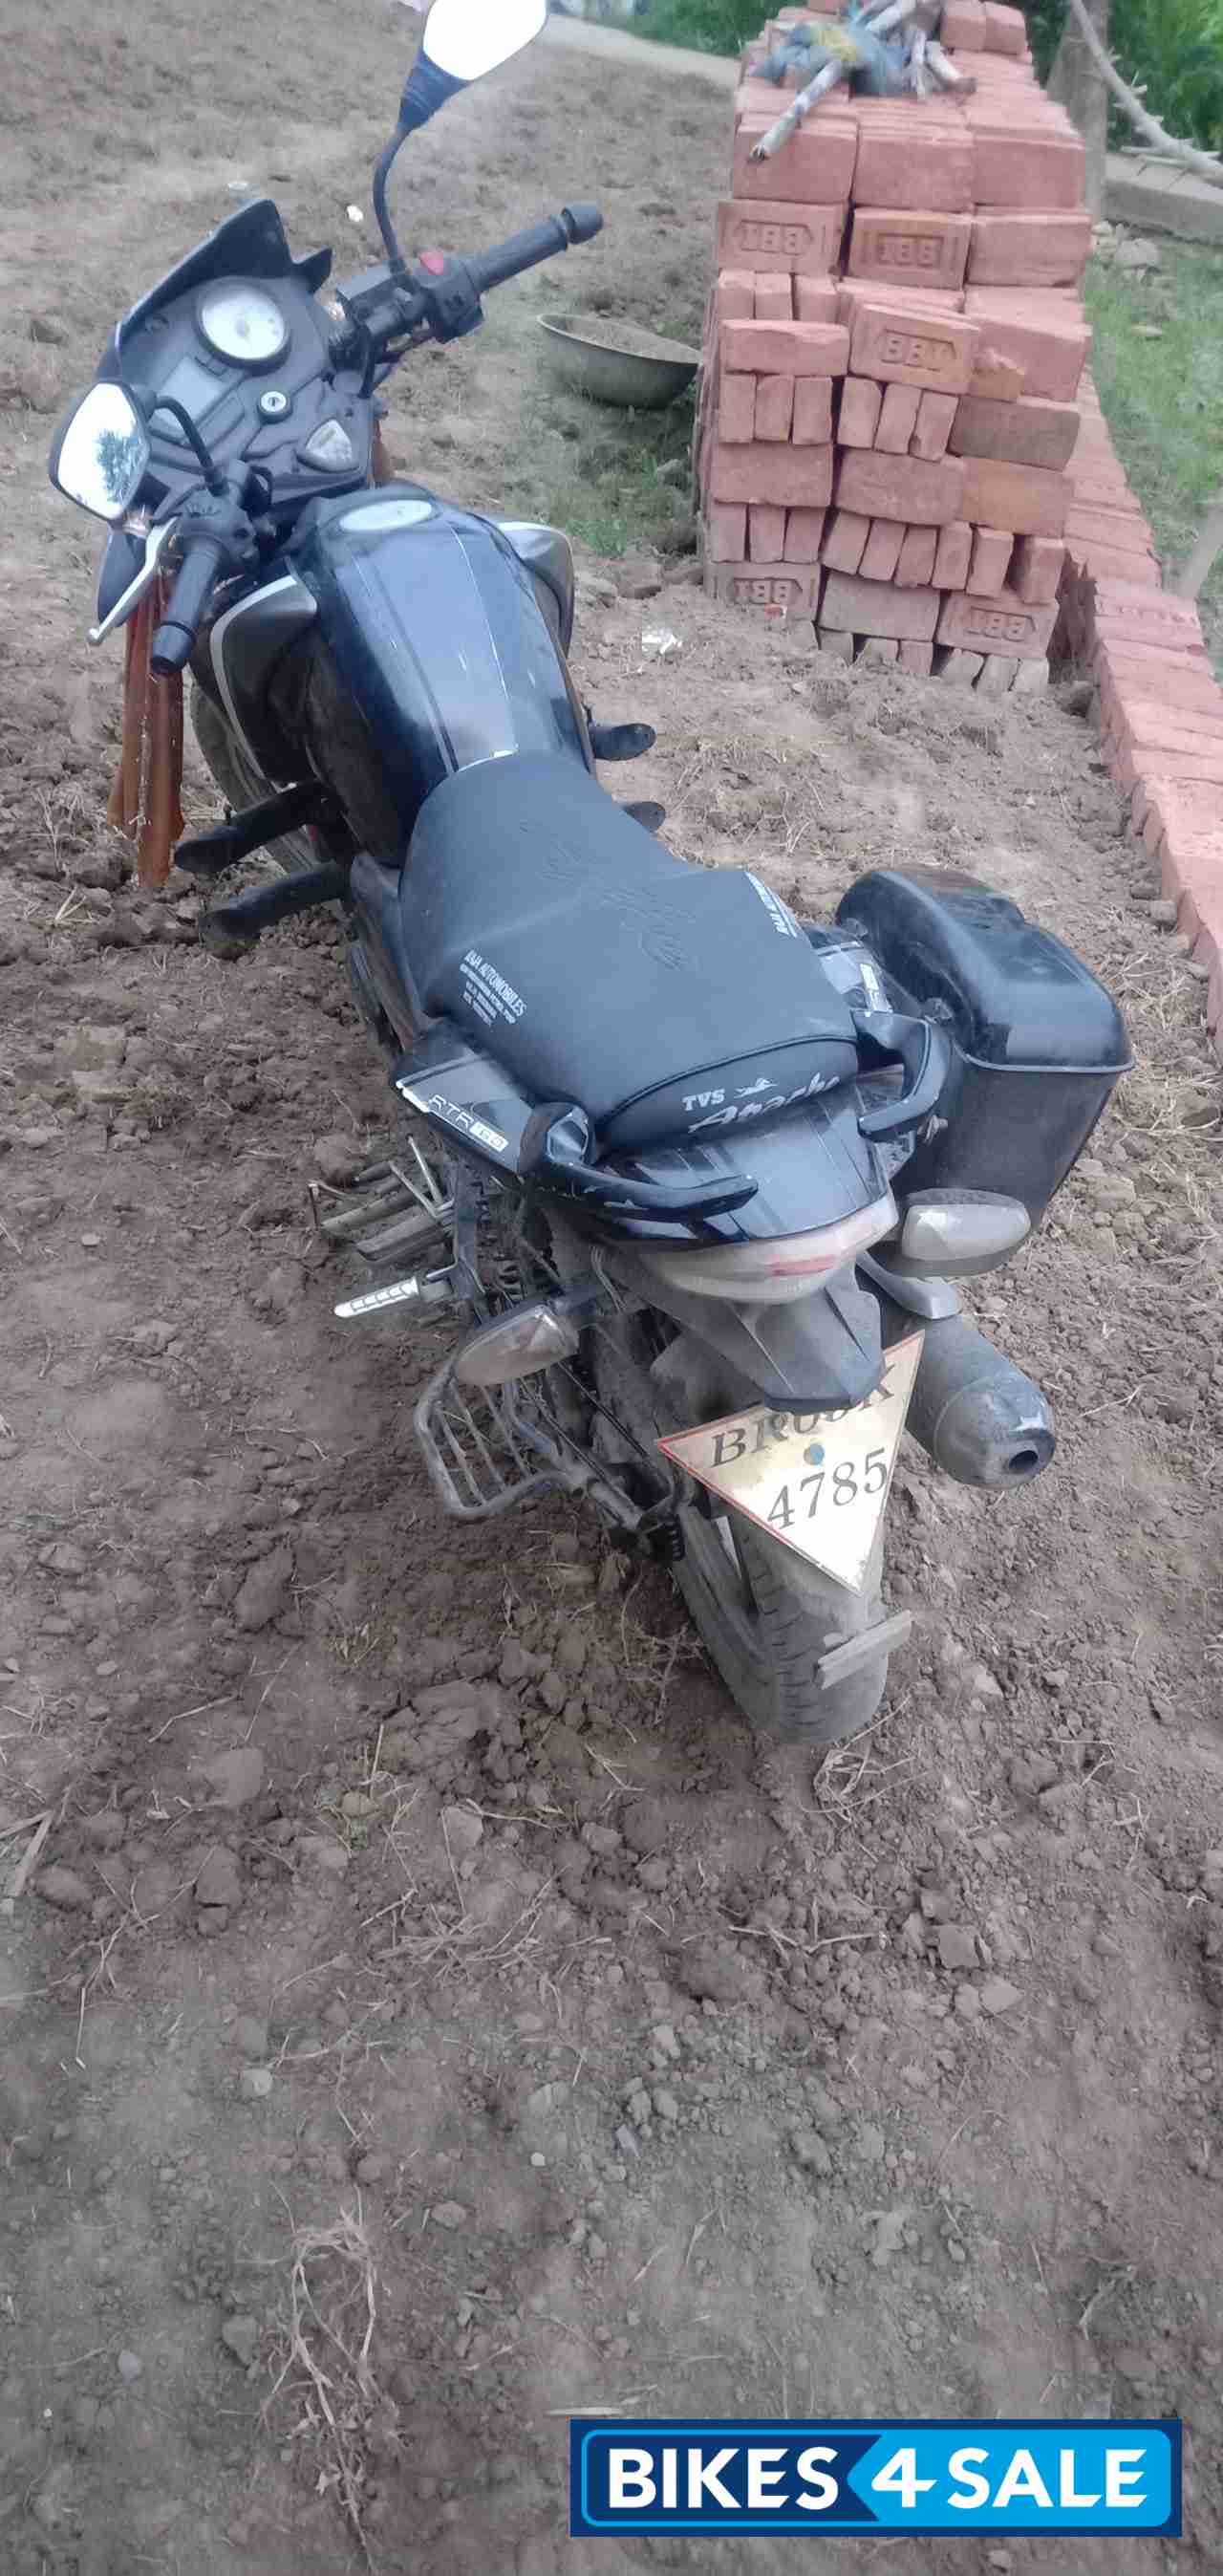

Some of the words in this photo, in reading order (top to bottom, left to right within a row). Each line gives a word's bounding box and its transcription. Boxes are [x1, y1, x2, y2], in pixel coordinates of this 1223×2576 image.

[479, 963, 527, 1017] AUTOMOBILES
[428, 1093, 475, 1132] RTR
[682, 1089, 726, 1112] TVS
[767, 1447, 890, 1530] 4785
